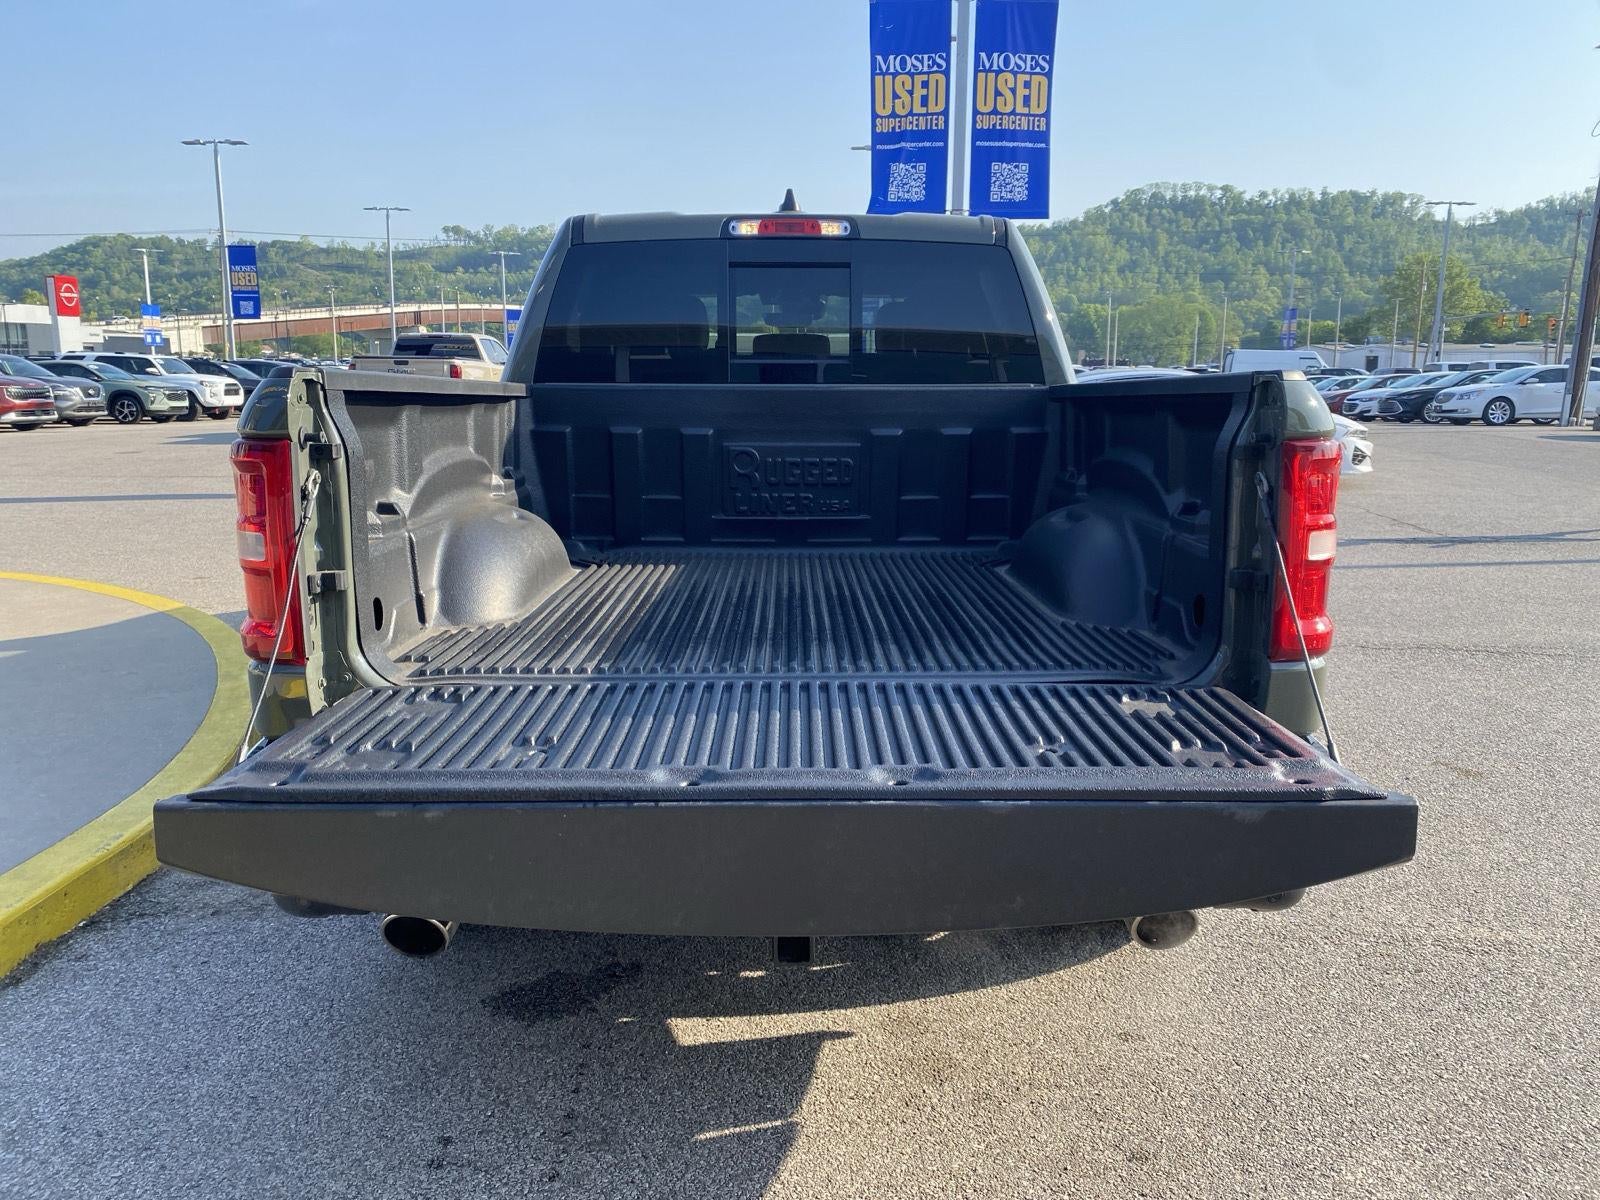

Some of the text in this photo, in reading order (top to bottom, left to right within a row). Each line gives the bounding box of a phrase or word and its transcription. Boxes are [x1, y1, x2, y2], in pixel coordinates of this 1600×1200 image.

[875, 52, 947, 73] MOSES
[978, 51, 1050, 73] MOSES
[875, 73, 946, 116] USED
[976, 72, 1049, 115] USED
[875, 115, 945, 133] SUPERCENTER
[976, 114, 1047, 131] SUPERCENTER
[876, 141, 945, 150] mosessupercenter.com
[231, 272, 257, 285] USED
[729, 446, 854, 488] RUGGED
